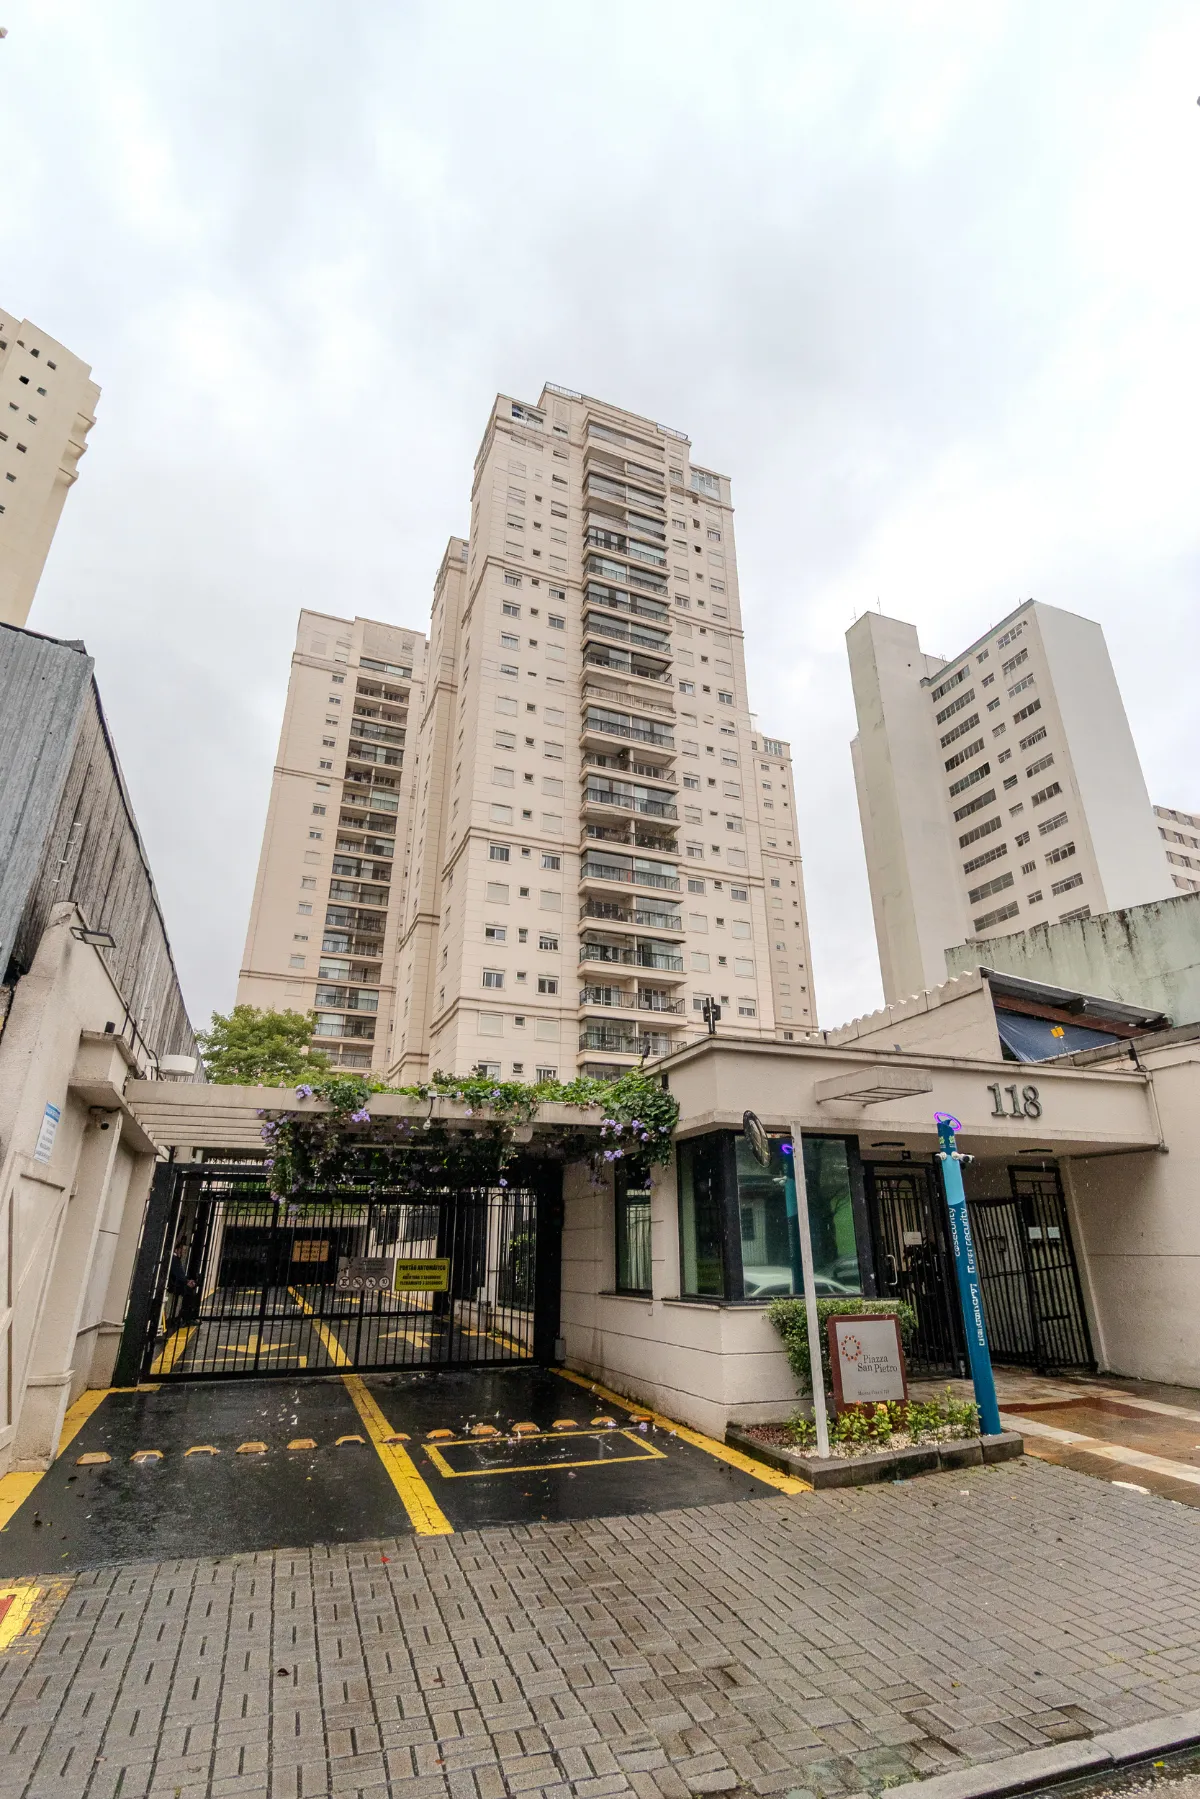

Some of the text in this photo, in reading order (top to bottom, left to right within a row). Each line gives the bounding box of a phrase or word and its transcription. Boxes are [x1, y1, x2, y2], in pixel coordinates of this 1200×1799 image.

[987, 1082, 1042, 1118] 118
[863, 1354, 889, 1364] Piazza
[857, 1362, 898, 1373] San Pietro
